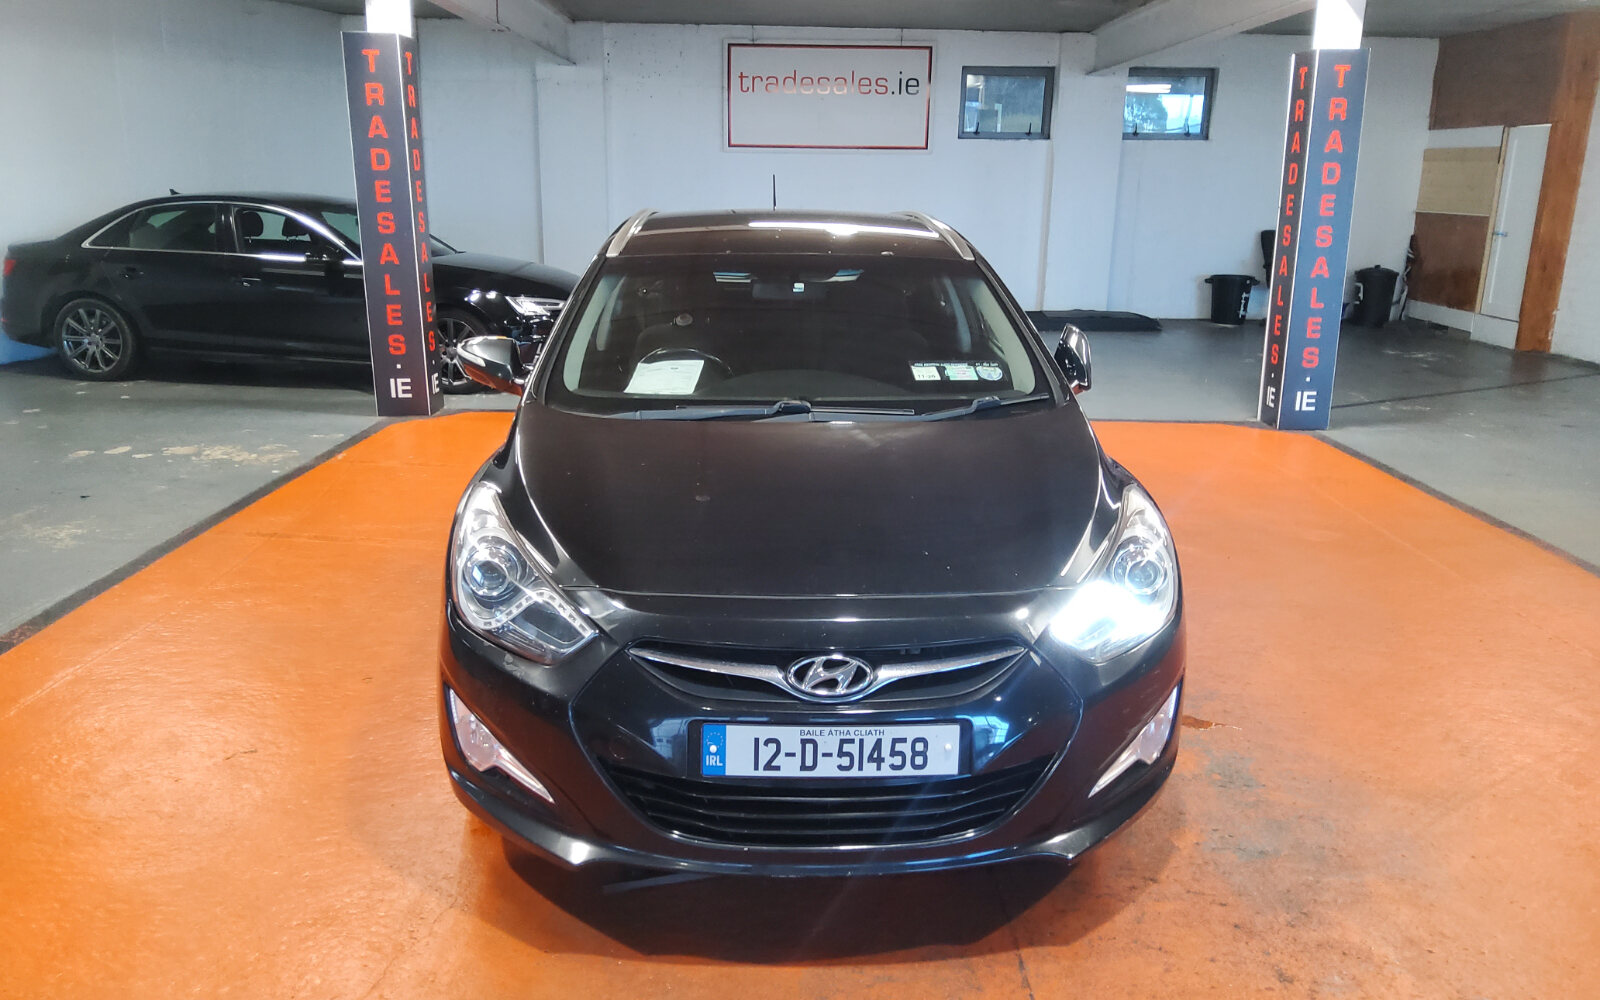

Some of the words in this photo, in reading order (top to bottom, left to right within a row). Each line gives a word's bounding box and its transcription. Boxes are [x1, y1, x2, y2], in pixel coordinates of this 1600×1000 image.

[738, 69, 920, 96] tradesales.ie
[361, 48, 413, 399] TRADESALES.IE
[1294, 64, 1352, 412] TRADESALES.IE
[799, 729, 826, 737] BAILE
[853, 729, 885, 737] CLIATH
[705, 755, 723, 767] IRL
[753, 737, 929, 772] 12-D-51458
